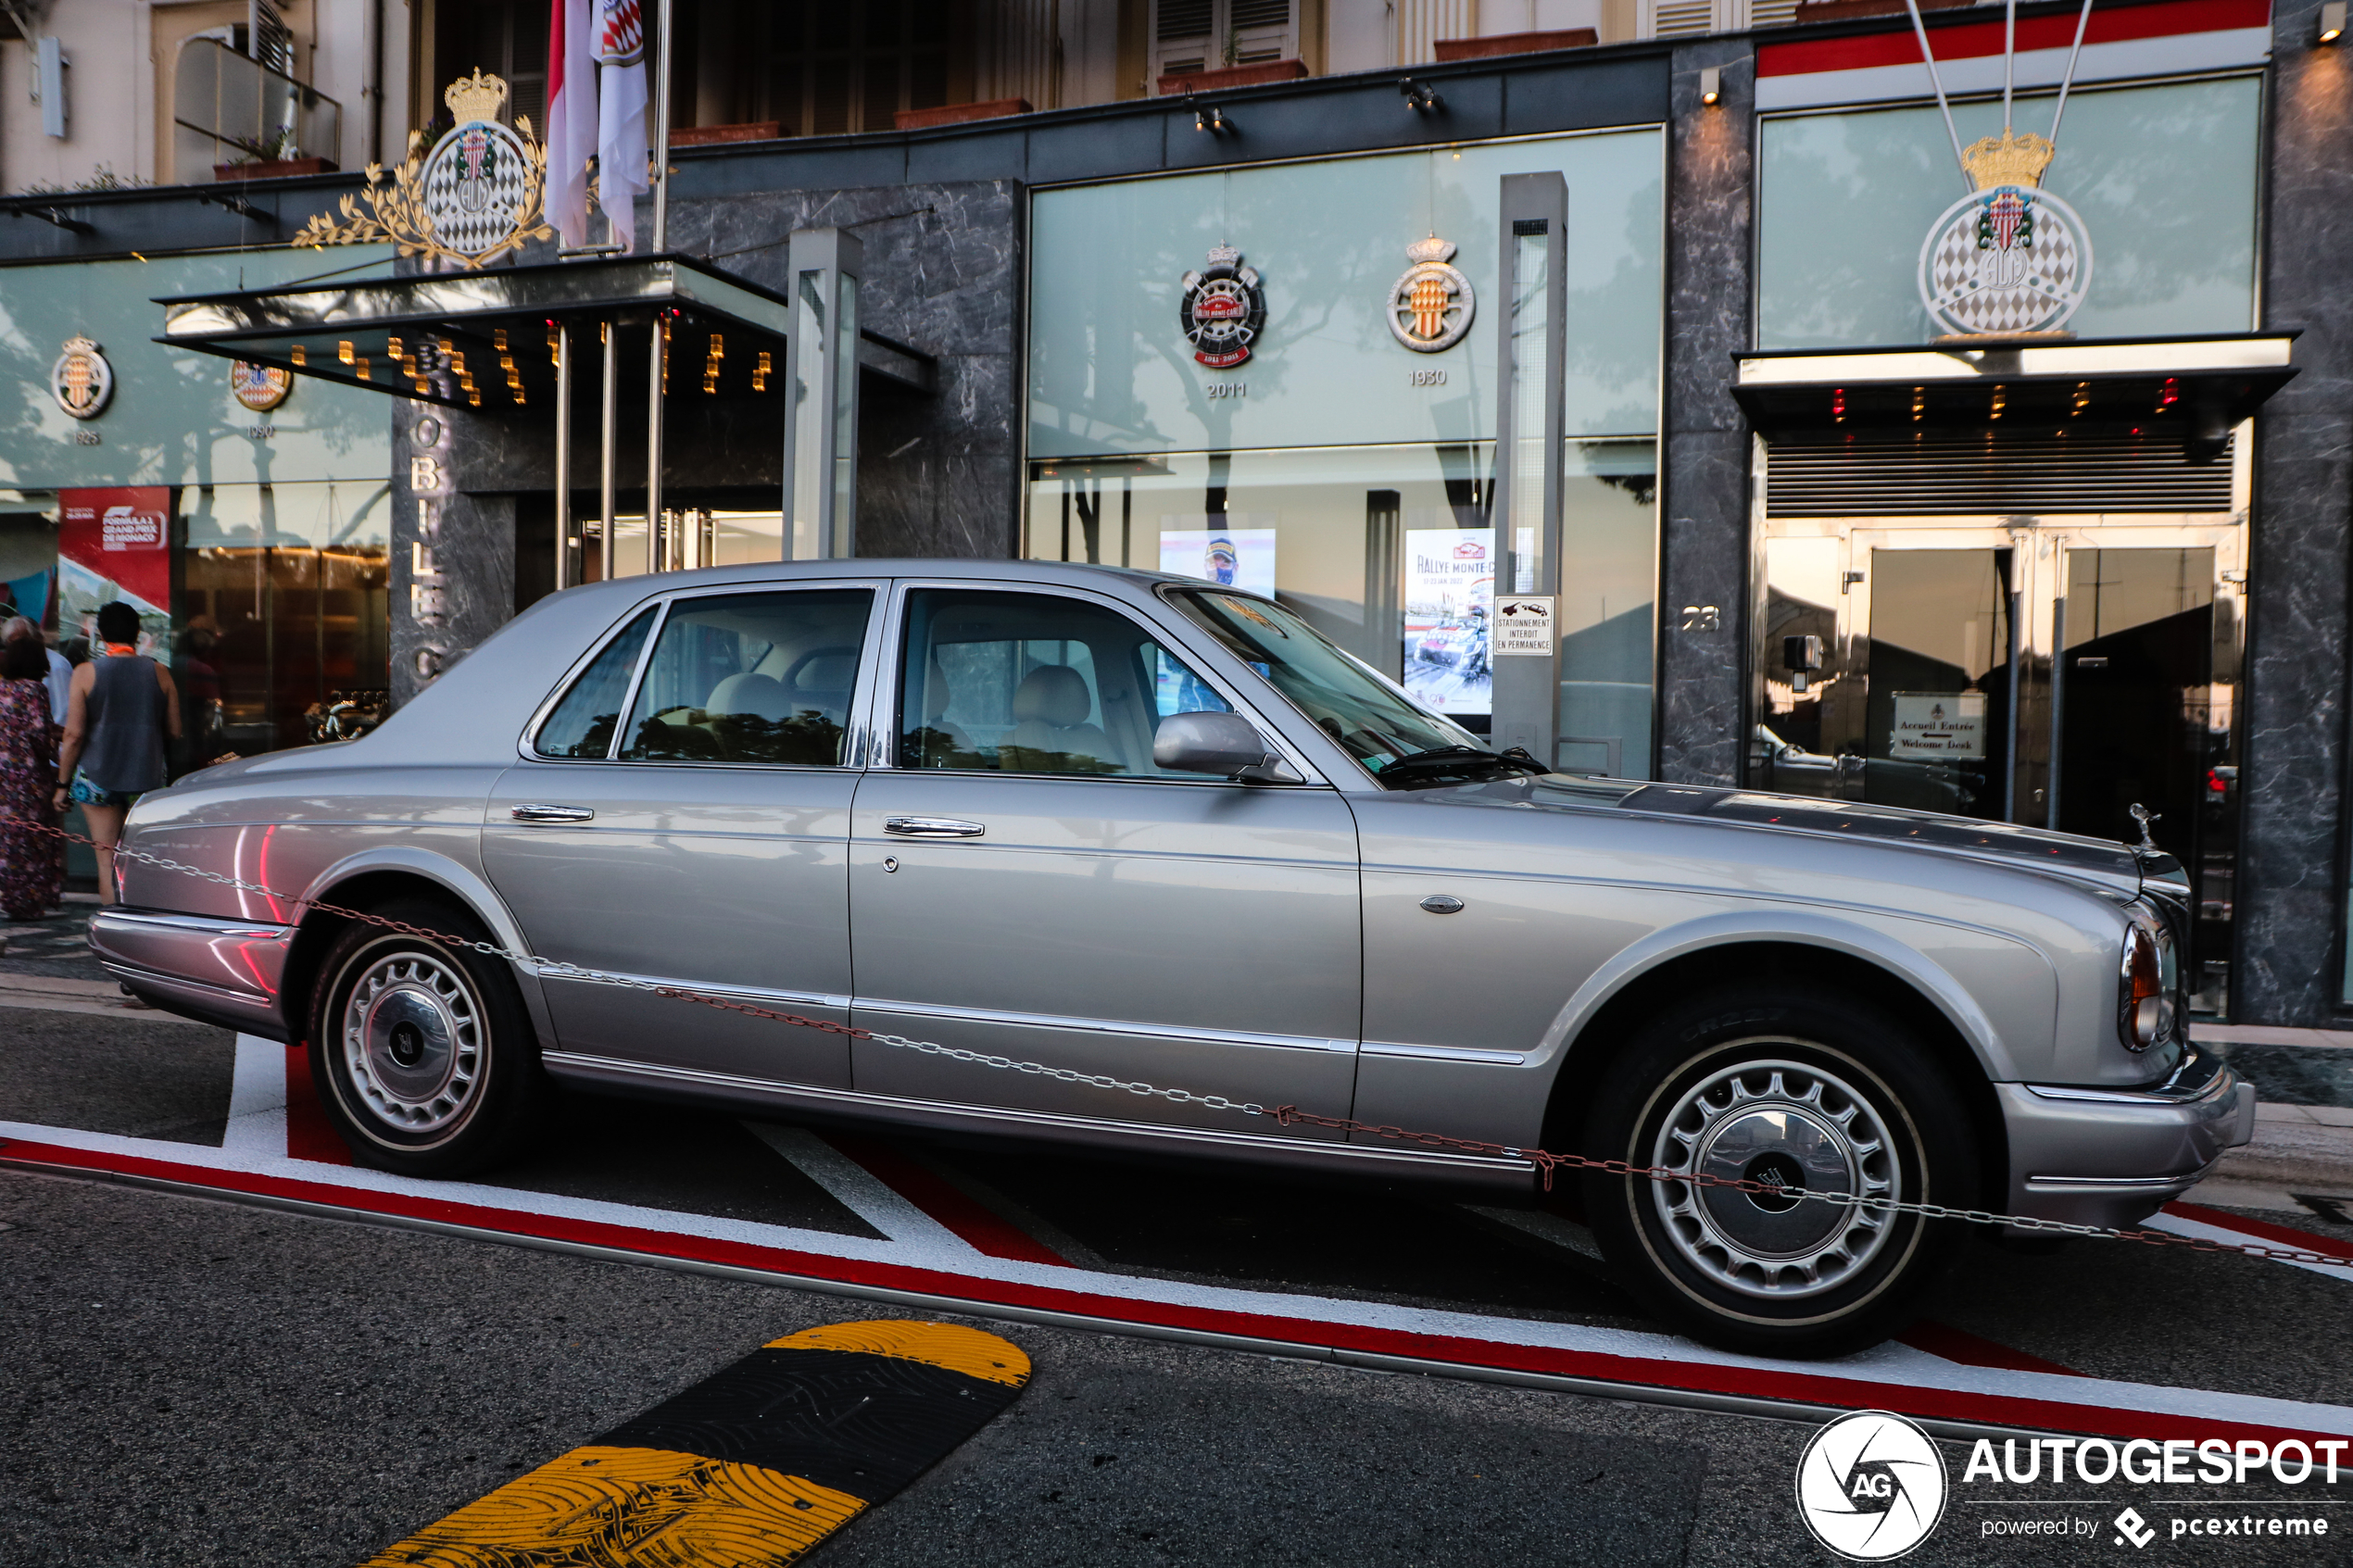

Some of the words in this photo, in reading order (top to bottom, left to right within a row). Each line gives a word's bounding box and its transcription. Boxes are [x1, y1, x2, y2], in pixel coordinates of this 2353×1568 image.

[1409, 370, 1447, 385] 1930
[1207, 382, 1246, 398] 2011
[245, 424, 274, 439] 1990
[73, 431, 101, 445] 1925
[103, 516, 145, 525] FORMULA
[147, 516, 154, 525] 1
[103, 525, 135, 533] GRAND
[135, 525, 157, 533] PRIX
[103, 533, 115, 542] DE
[116, 533, 156, 542] MONACO
[1417, 554, 1450, 574] RALLYE
[1450, 577, 1464, 585] 2022
[1498, 619, 1551, 628] STATIONNEMENT
[1509, 629, 1539, 638] INTERDIT
[1497, 640, 1506, 649] EN
[1507, 640, 1551, 649] PERMANENCE
[1900, 721, 1936, 731] Accueil
[1940, 721, 1975, 731] Entrée
[1901, 738, 1944, 749] Welcome
[1947, 740, 1973, 750] Desk
